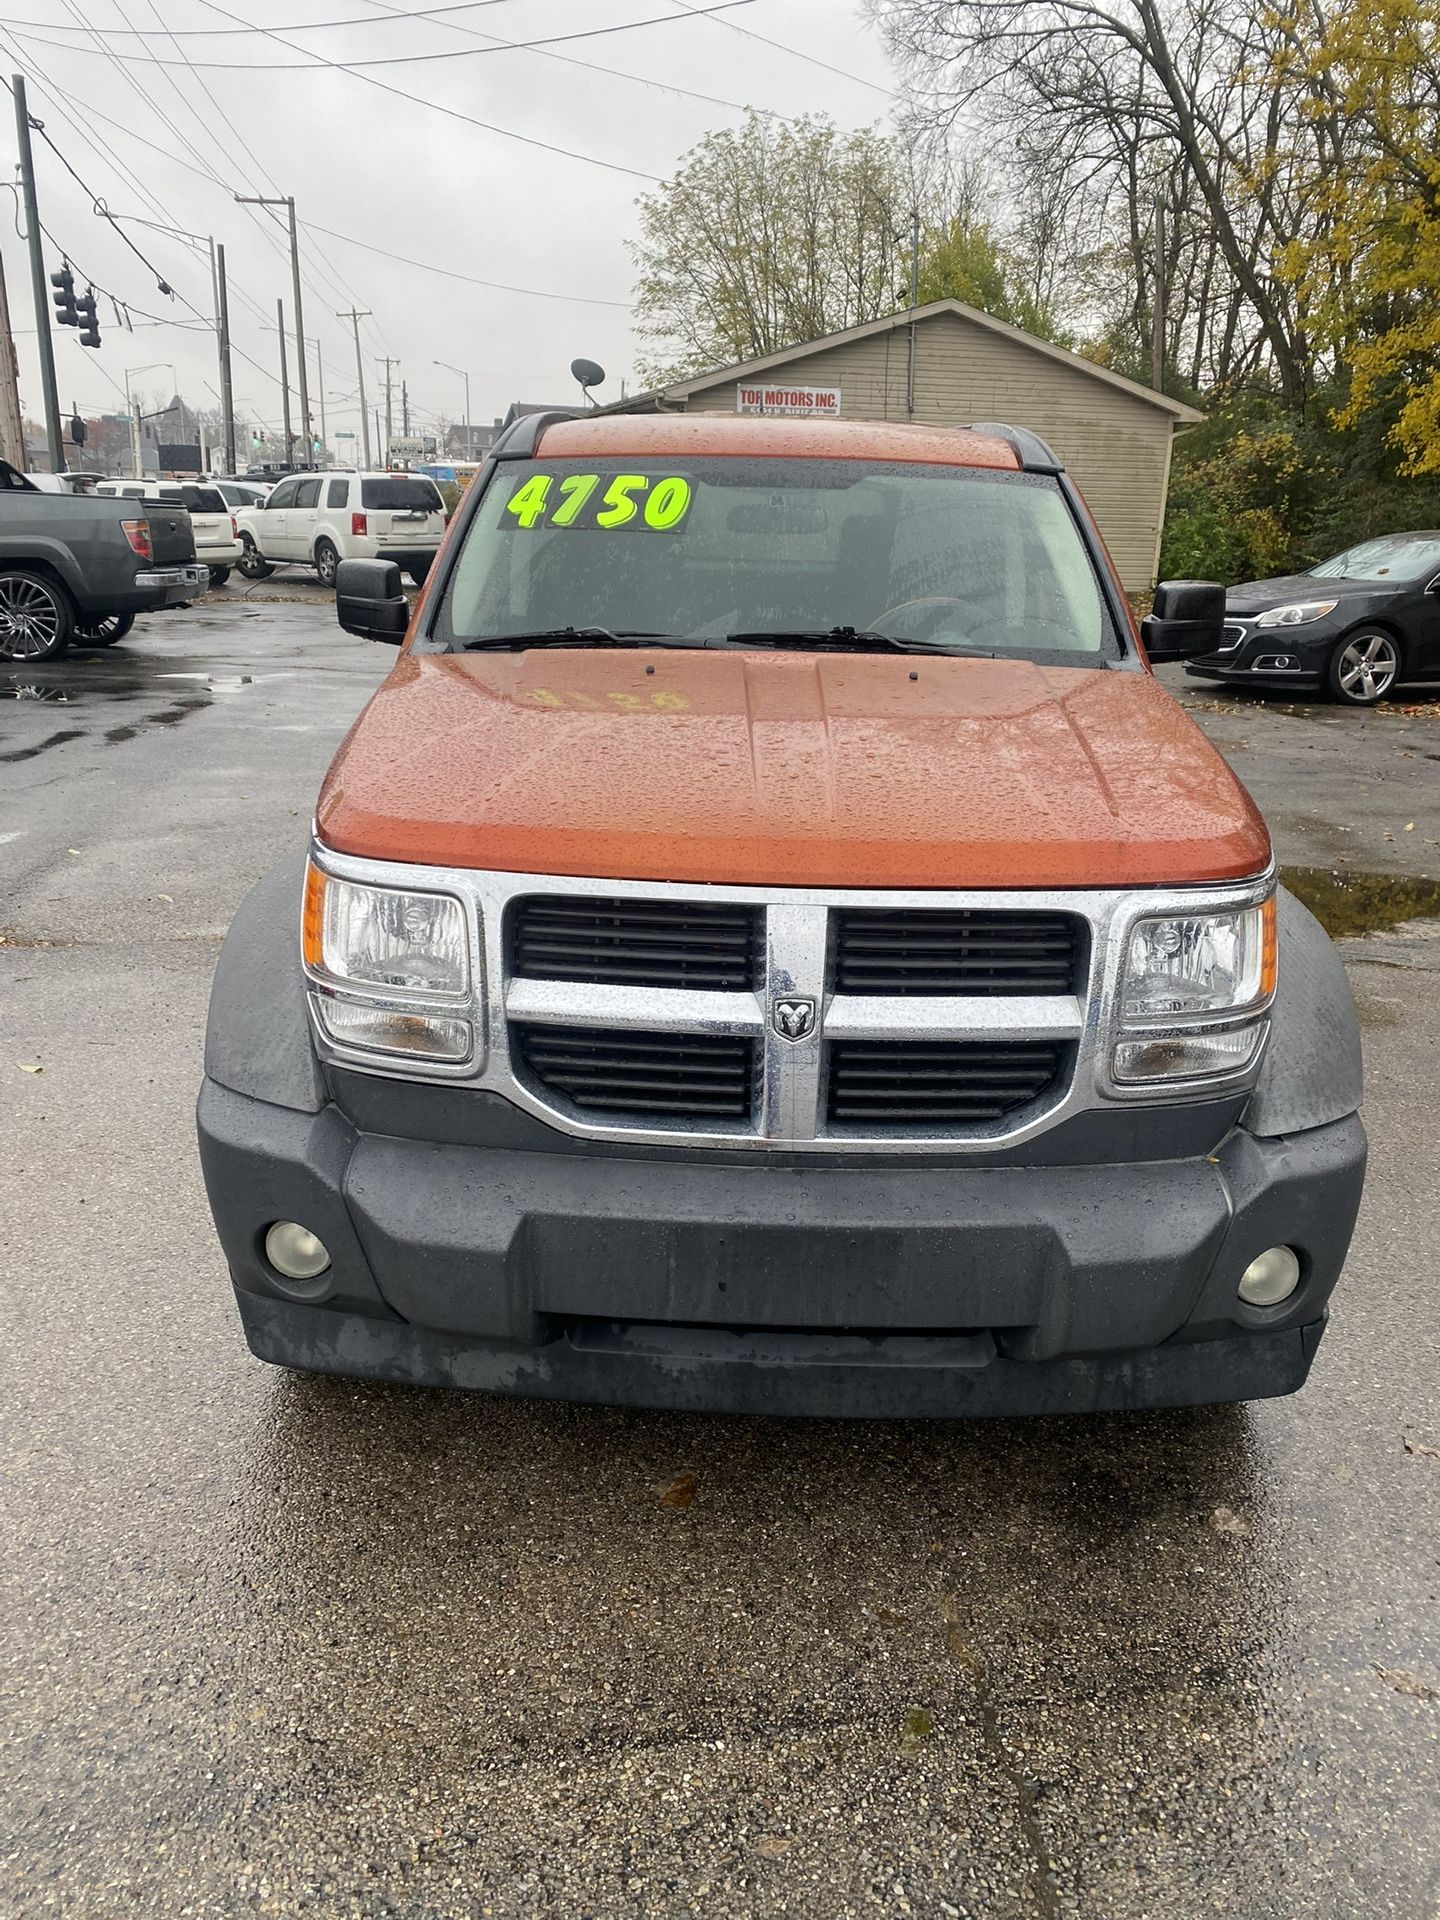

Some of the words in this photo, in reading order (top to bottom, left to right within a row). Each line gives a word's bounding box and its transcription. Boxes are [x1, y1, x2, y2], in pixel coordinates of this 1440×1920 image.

[740, 390, 763, 404] TOP
[765, 391, 813, 407] MOTORS
[815, 393, 838, 408] INC.
[506, 474, 692, 530] 4750
